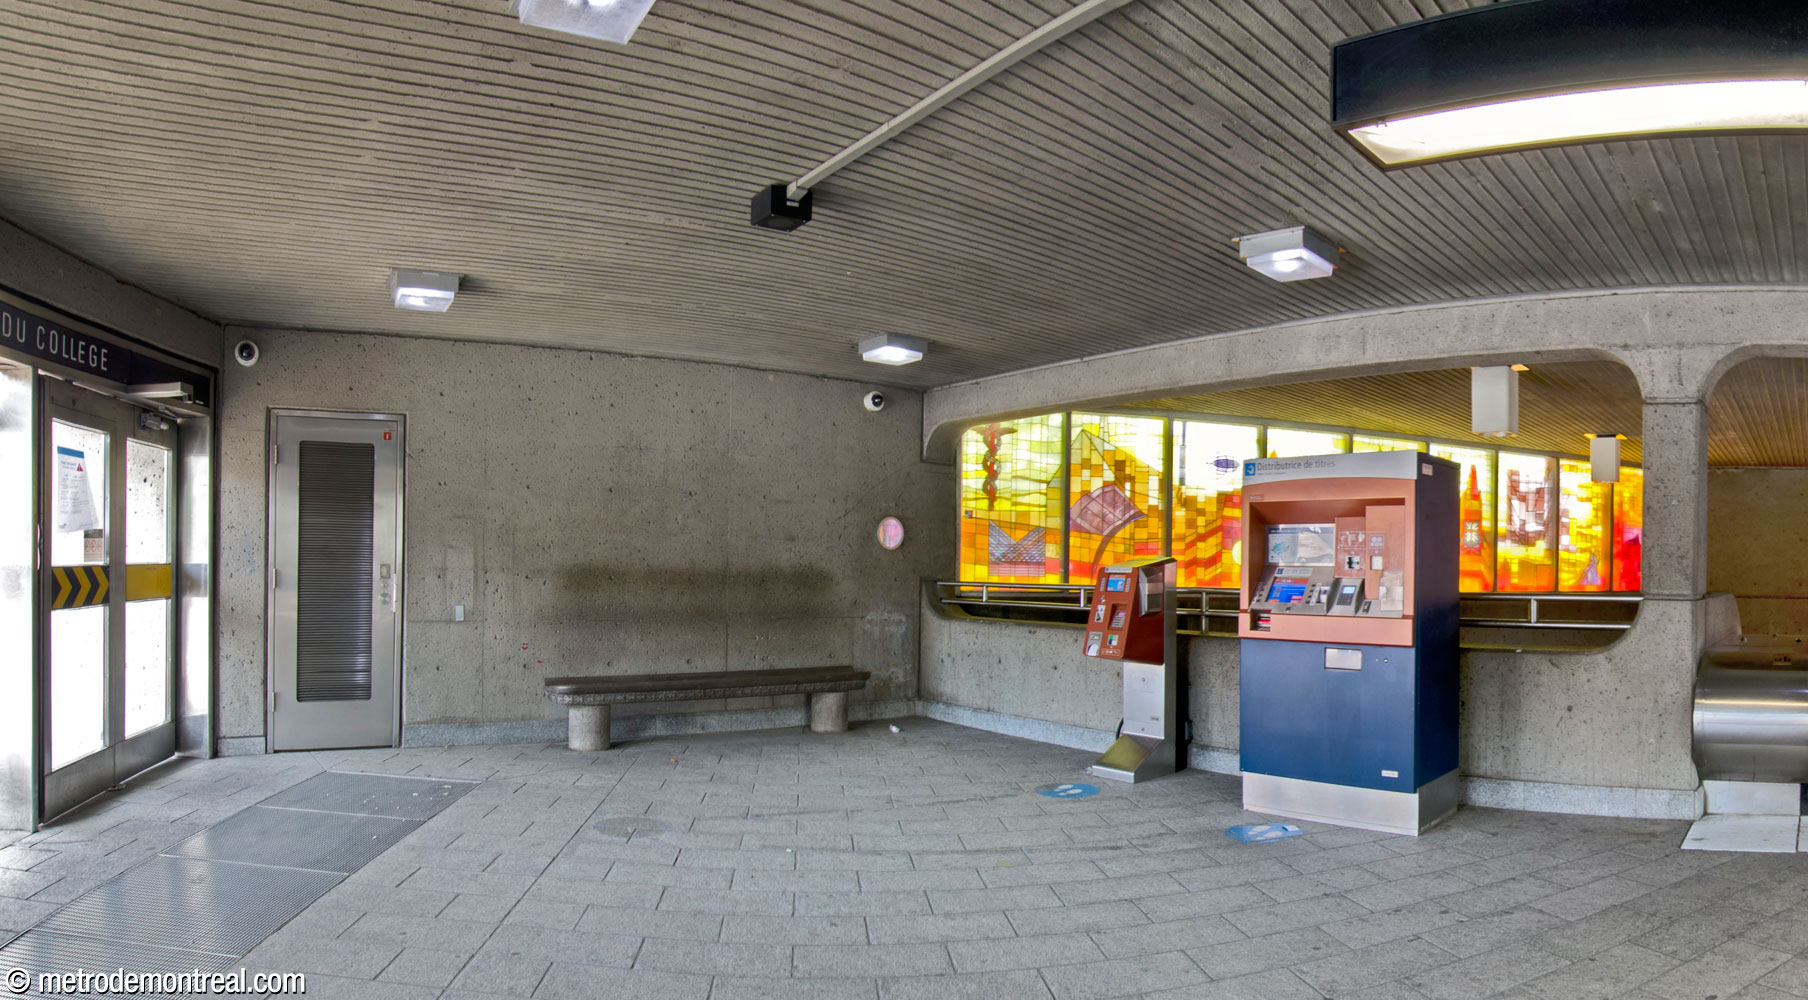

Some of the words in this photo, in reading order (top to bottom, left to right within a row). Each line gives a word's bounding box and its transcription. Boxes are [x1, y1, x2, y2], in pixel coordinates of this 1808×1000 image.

[2, 311, 26, 343] DU
[36, 325, 108, 371] COLLEGE
[1257, 461, 1302, 471] Distributrice
[1304, 460, 1313, 468] de
[1315, 459, 1336, 468] titres
